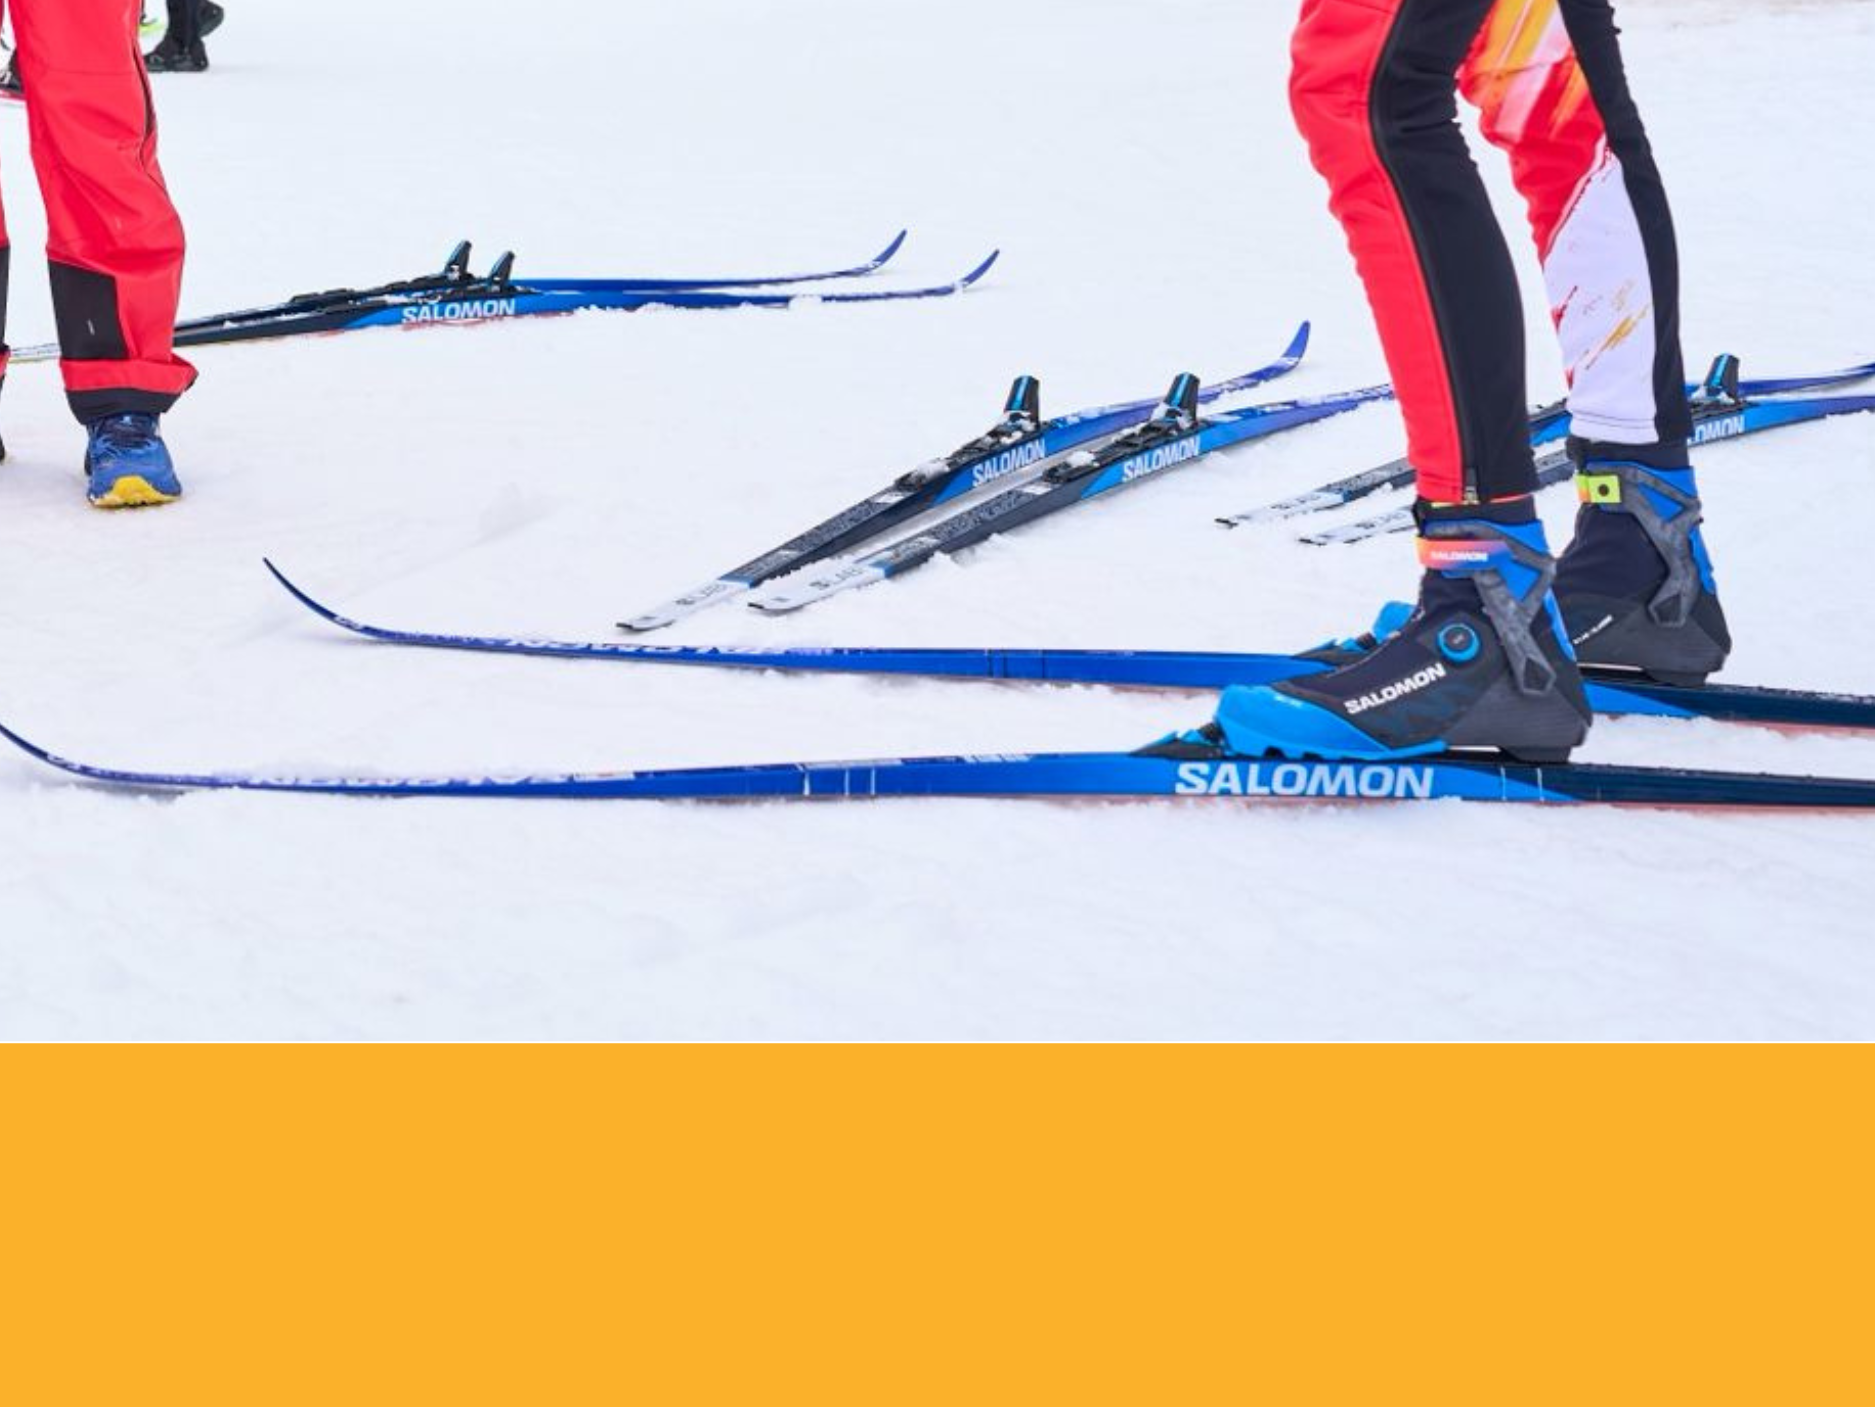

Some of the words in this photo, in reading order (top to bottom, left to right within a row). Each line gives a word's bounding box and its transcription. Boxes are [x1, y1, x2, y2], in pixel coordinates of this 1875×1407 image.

[401, 298, 516, 324] SALOMON
[972, 439, 1046, 487] SALOMON
[1122, 436, 1202, 482] SALOMON
[1343, 662, 1447, 715] SALOMON
[1175, 762, 1435, 798] SALOMON
